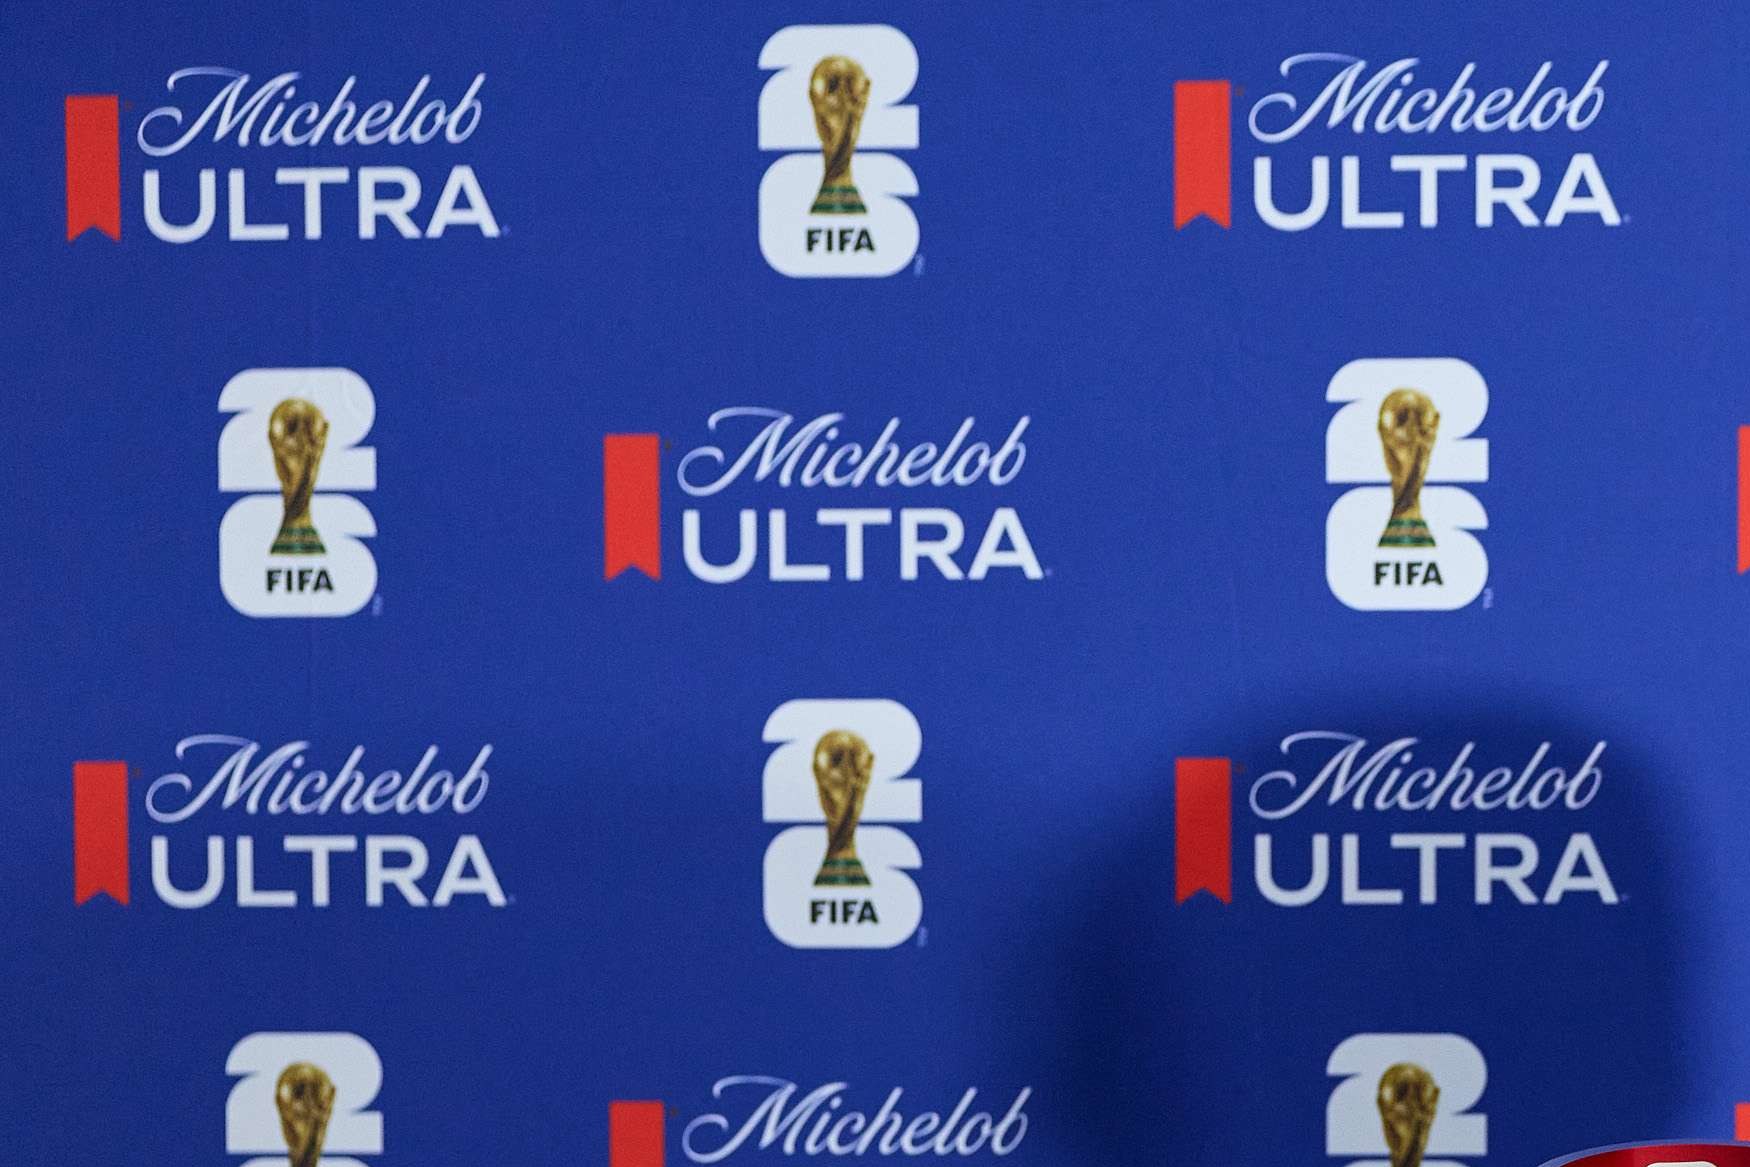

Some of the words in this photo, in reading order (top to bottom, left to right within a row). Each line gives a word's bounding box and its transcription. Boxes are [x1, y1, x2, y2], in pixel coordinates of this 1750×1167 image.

[138, 68, 485, 156] Michelob
[1249, 53, 1608, 142] Michelob
[143, 165, 500, 243] ULTRA
[1254, 153, 1621, 231] ULTRA
[806, 228, 875, 253] FIFA
[678, 408, 1029, 496] Michelob
[266, 568, 334, 593] FIFA
[683, 508, 1043, 583] ULTRA
[1374, 561, 1443, 586] FIFA
[146, 735, 492, 822] Michelob
[1250, 731, 1606, 819] Michelob
[152, 835, 506, 908] ULTRA
[1255, 833, 1618, 906] ULTRA
[810, 900, 879, 924] FIFA
[683, 1077, 1030, 1163] Michelob
